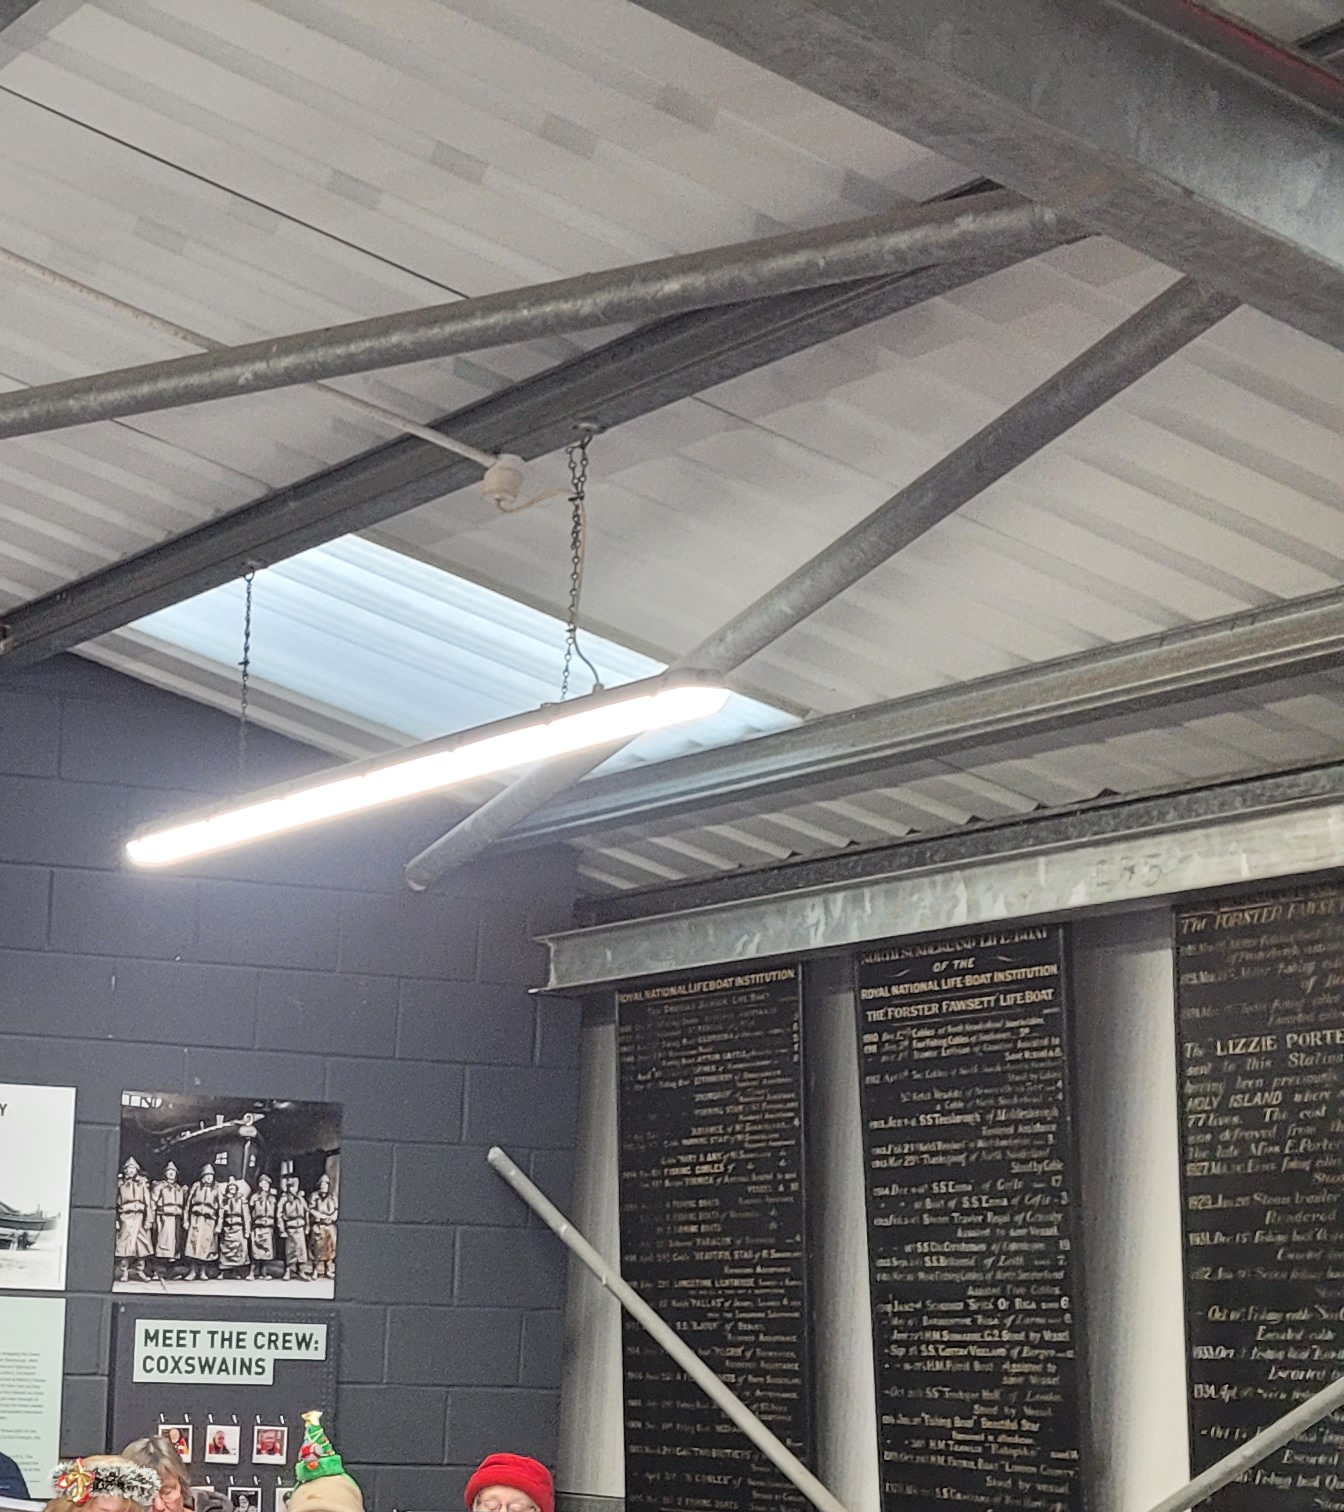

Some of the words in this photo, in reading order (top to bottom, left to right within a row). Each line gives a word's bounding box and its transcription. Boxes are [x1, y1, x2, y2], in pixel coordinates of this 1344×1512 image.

[932, 961, 948, 973] OF
[952, 957, 976, 970] THE
[644, 985, 688, 1001] NATIONAL
[734, 969, 795, 986] INSTITUTION
[861, 988, 891, 1000] ROYAL
[891, 980, 940, 996] NATIONAL
[993, 964, 1058, 981] INSTITUTION
[1228, 1091, 1283, 1108] ISLAND
[144, 1329, 200, 1349] MEET
[207, 1330, 247, 1349] THE
[253, 1331, 320, 1351] CREW:
[142, 1356, 267, 1376] COXSWAINS
